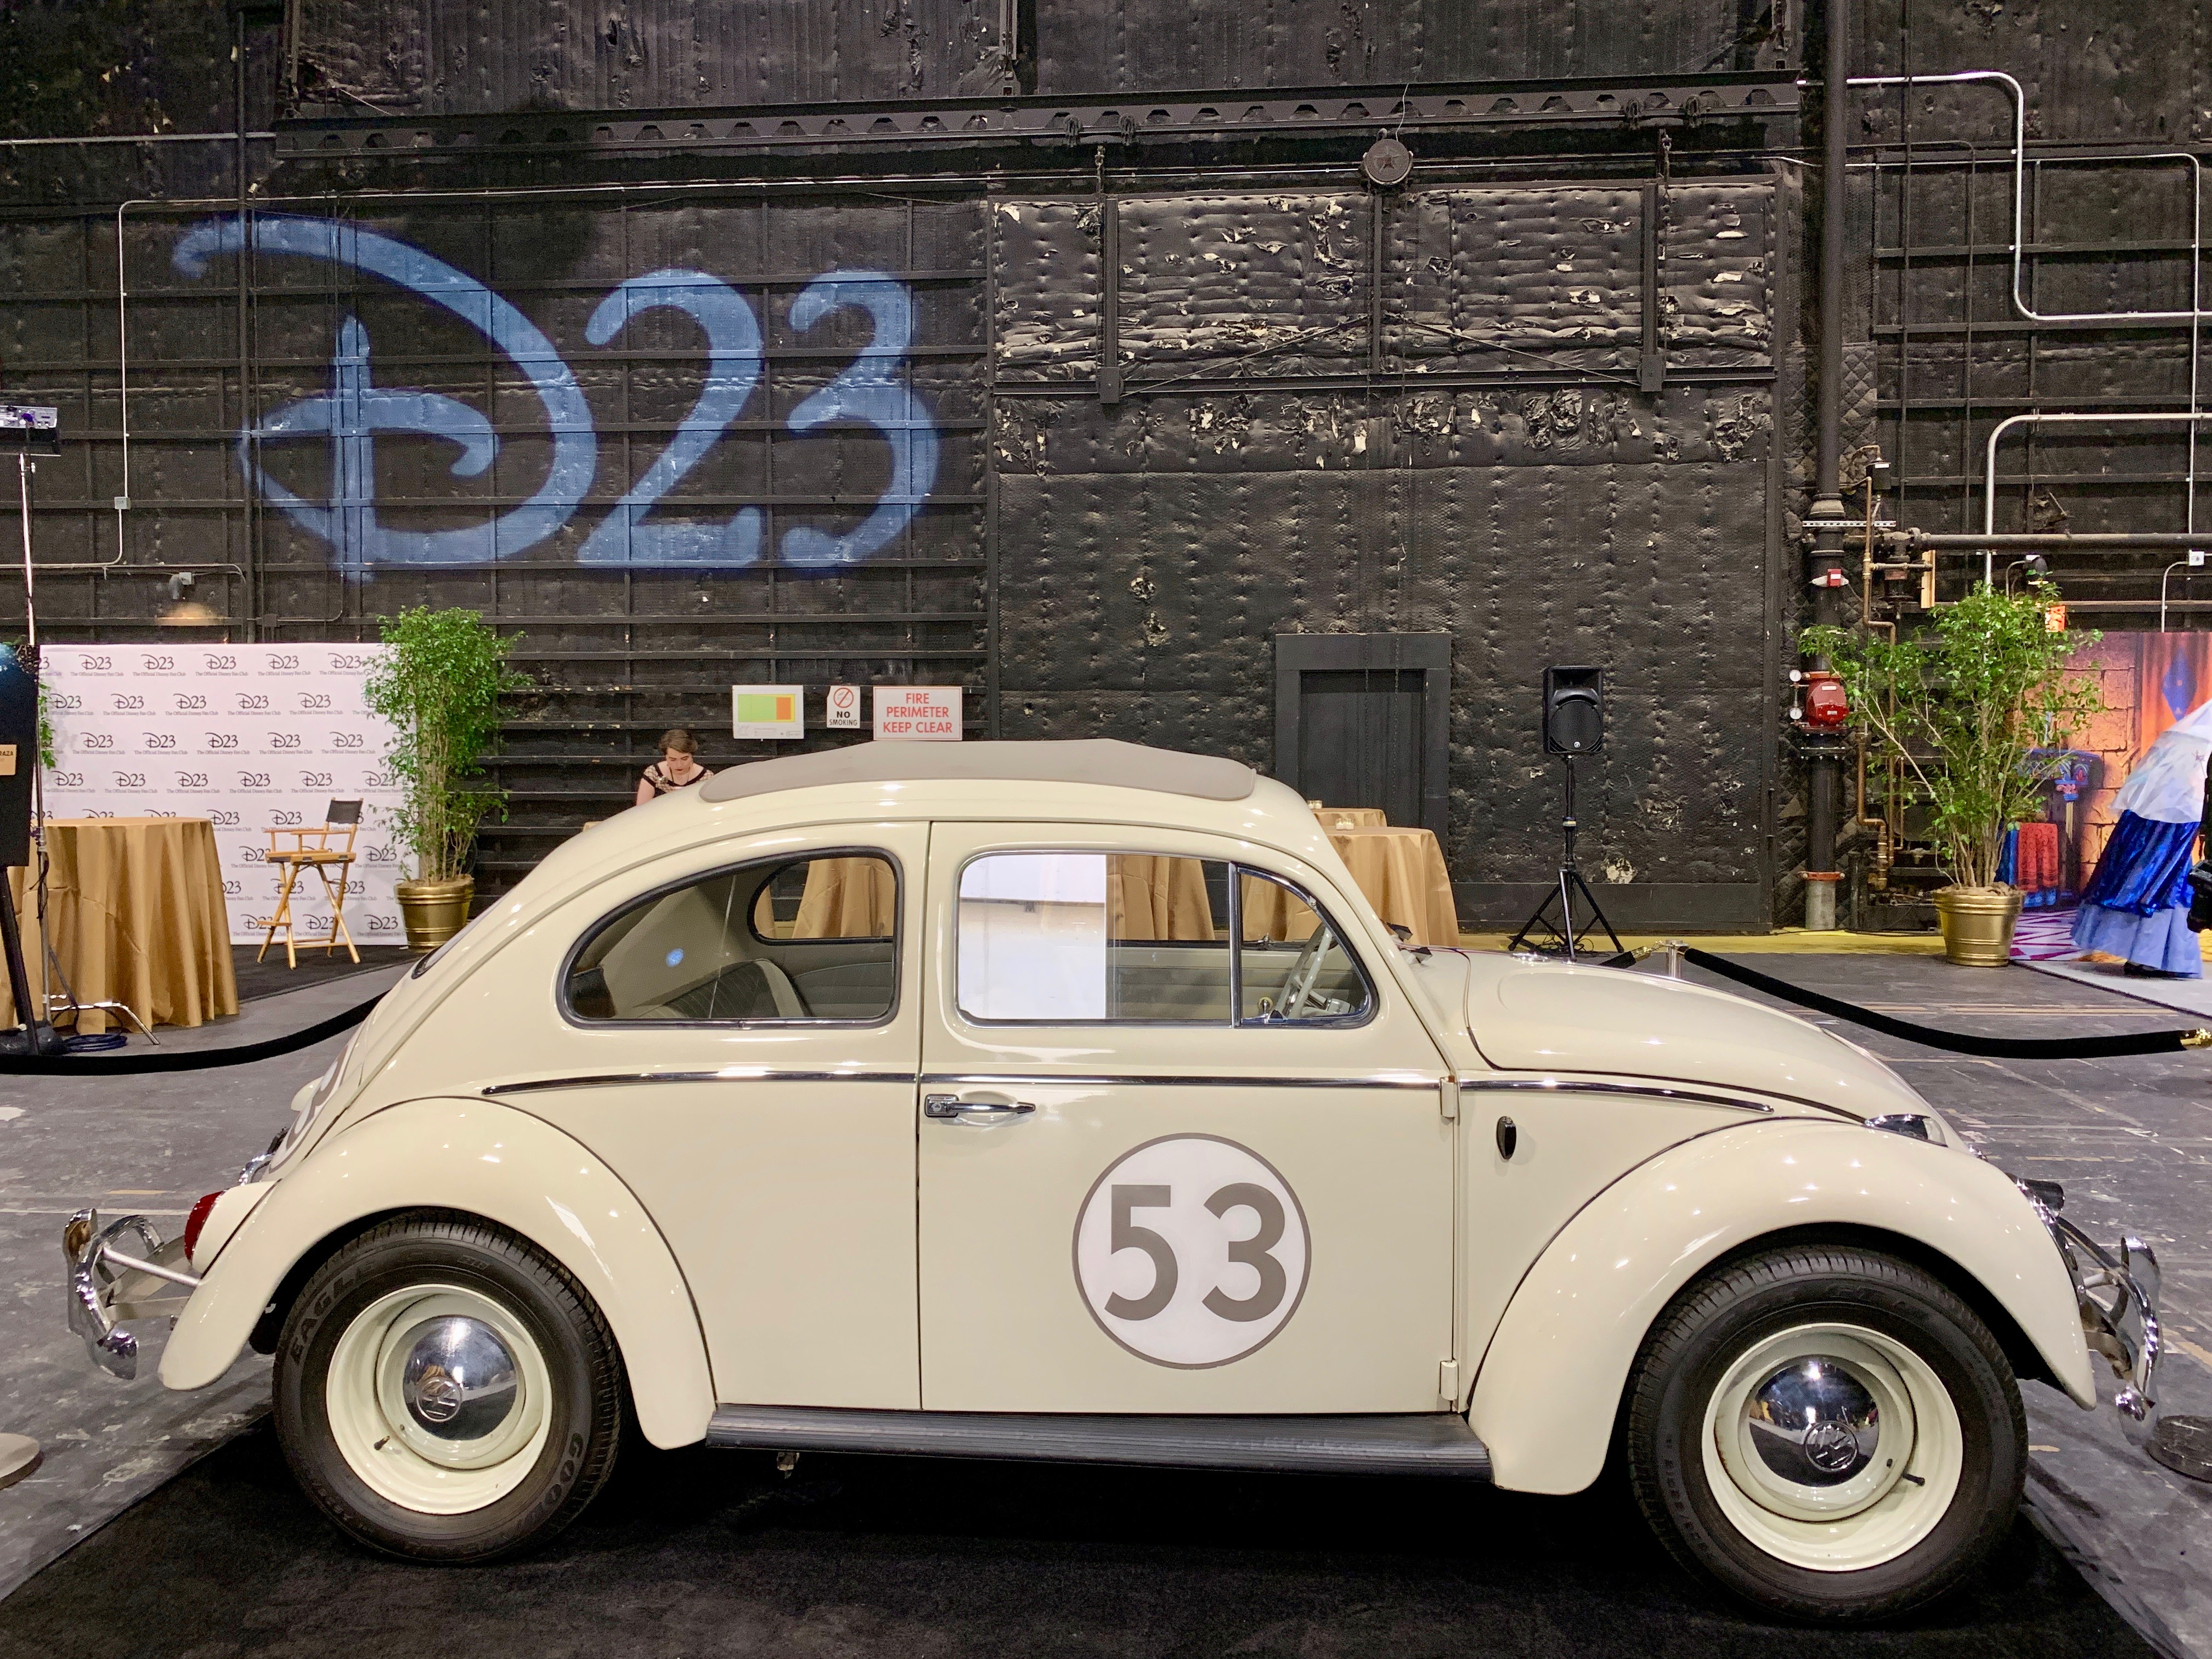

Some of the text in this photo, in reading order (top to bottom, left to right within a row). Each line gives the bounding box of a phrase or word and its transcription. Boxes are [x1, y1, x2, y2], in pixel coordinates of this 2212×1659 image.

[171, 218, 938, 582] D23
[78, 654, 112, 670] D23
[140, 654, 174, 670] D23
[203, 653, 236, 669] D23
[266, 653, 299, 669] D23
[327, 653, 361, 669] D23
[48, 693, 82, 709] D23
[111, 693, 144, 709] D23
[172, 693, 206, 709] D23
[235, 693, 269, 709] D23
[297, 692, 331, 708] D23
[906, 693, 929, 704] FIRE
[886, 707, 949, 718] PERIMETER
[883, 722, 952, 733] KEEP CLEAR
[80, 732, 114, 748] D23
[142, 732, 176, 748] D23
[204, 732, 238, 748] D23
[267, 732, 301, 748] D23
[329, 731, 363, 747] D23
[50, 770, 84, 786] D23
[112, 771, 146, 787] D23
[174, 771, 208, 787] D23
[237, 771, 270, 787] D23
[298, 770, 332, 786] D23
[269, 809, 302, 825] D23
[364, 914, 398, 930] D23
[1104, 1182, 1286, 1322] 53
